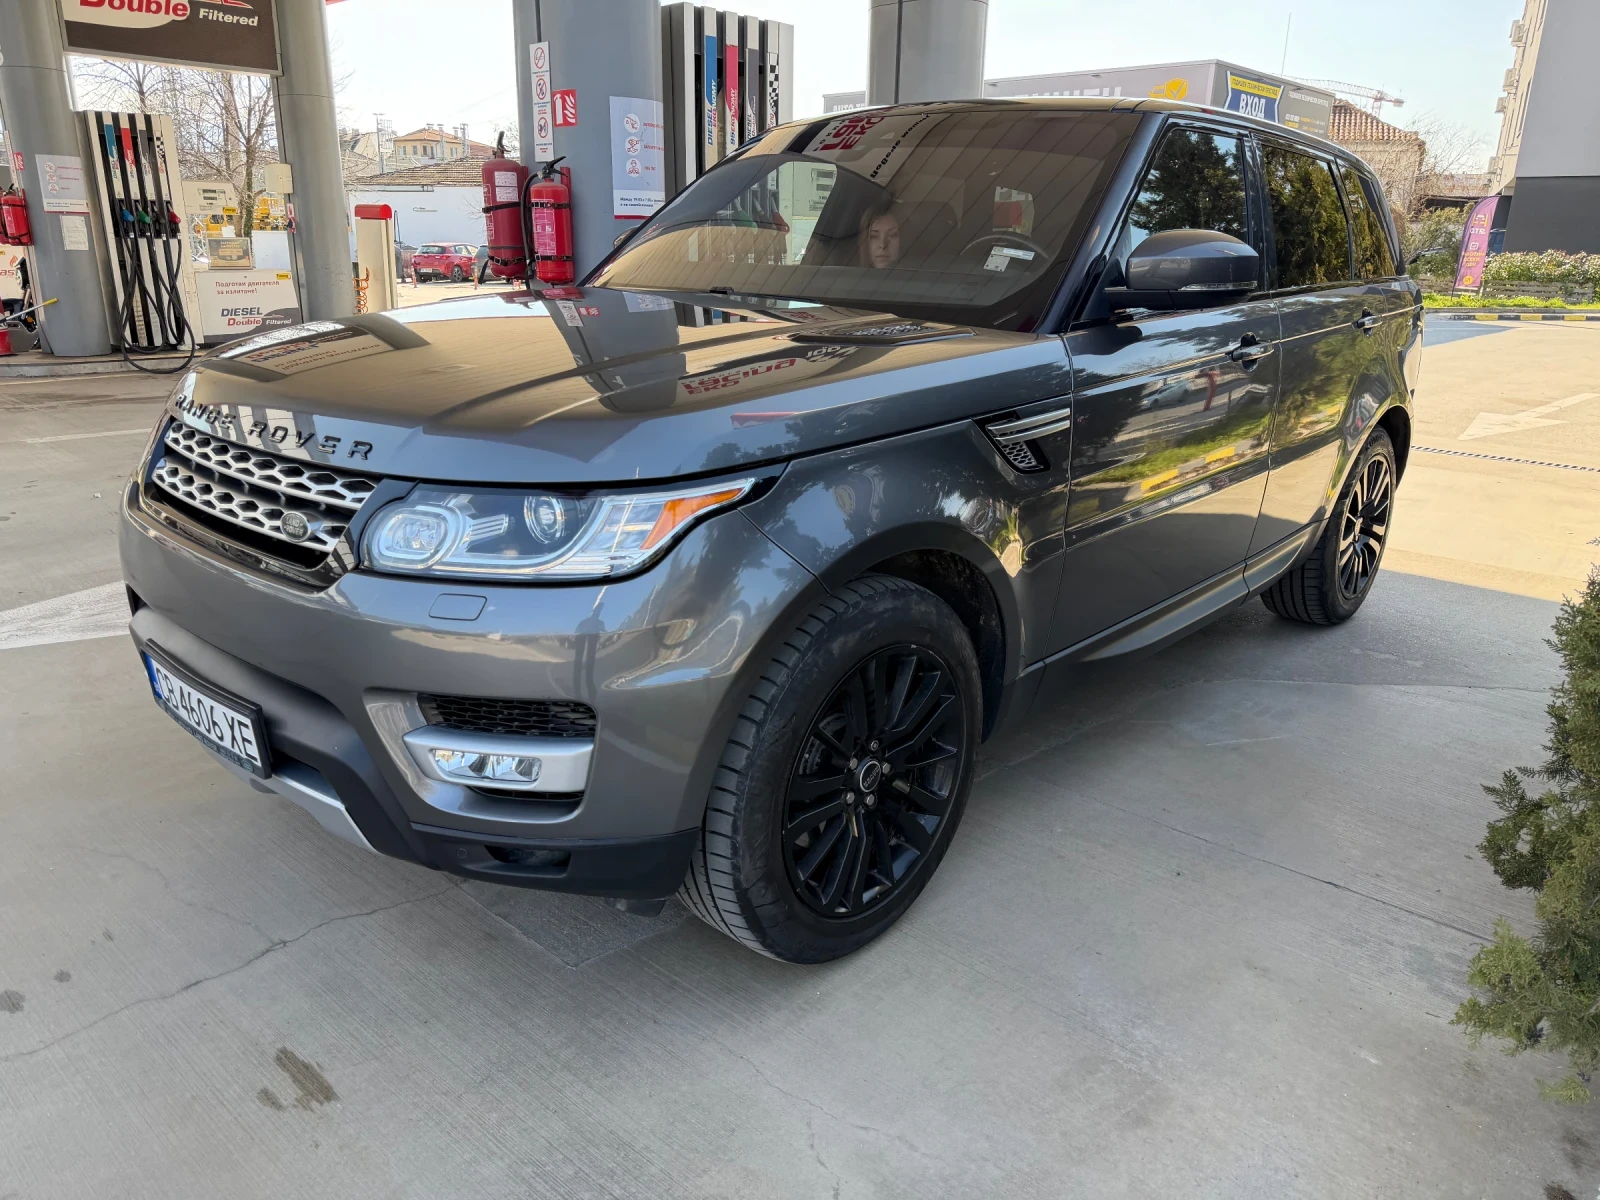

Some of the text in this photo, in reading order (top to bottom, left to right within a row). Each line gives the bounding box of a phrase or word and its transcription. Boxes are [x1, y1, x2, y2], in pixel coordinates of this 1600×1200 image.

[199, 8, 259, 27] Filtered
[1239, 93, 1266, 119] ВХОД
[221, 307, 263, 317] DIESEL
[227, 318, 262, 327] Double
[175, 394, 374, 461] RANGE ROVER
